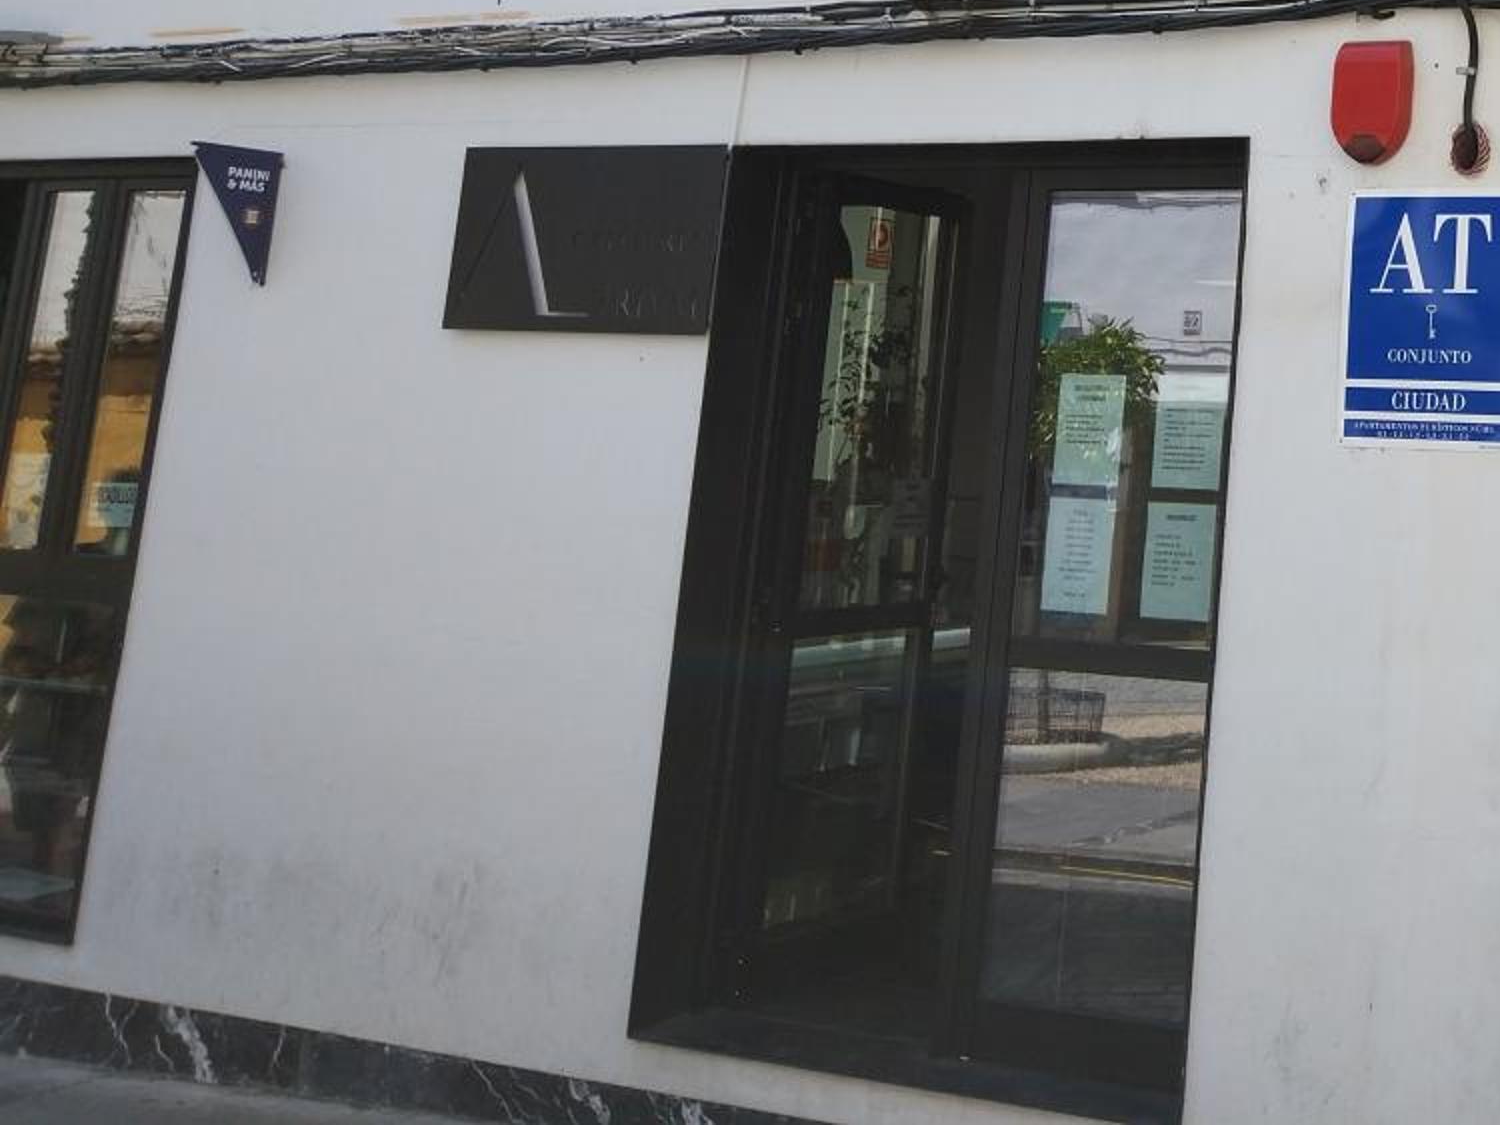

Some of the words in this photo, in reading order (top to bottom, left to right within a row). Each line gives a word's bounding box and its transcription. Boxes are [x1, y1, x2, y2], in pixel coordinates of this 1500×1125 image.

[227, 166, 271, 181] PANINI
[1369, 211, 1494, 296] AT
[1387, 348, 1473, 365] CONJUNTO
[1390, 390, 1467, 412] CIUDAD
